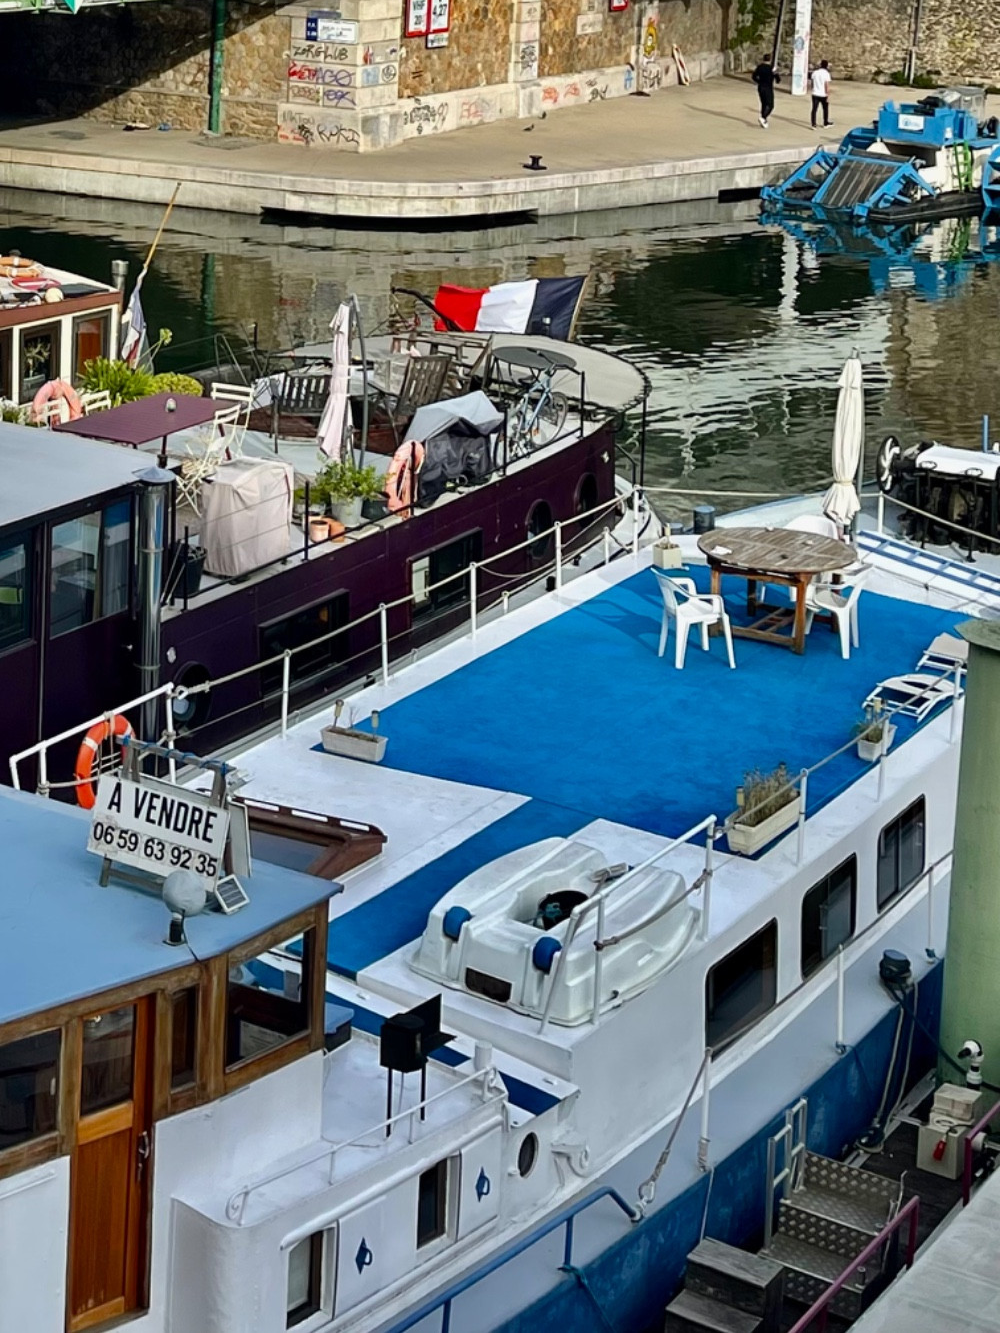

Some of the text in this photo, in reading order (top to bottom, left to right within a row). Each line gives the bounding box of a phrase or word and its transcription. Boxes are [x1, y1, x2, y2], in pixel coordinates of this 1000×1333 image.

[134, 787, 218, 844] VENDRE
[93, 822, 218, 877] 06 59 63 92 35
